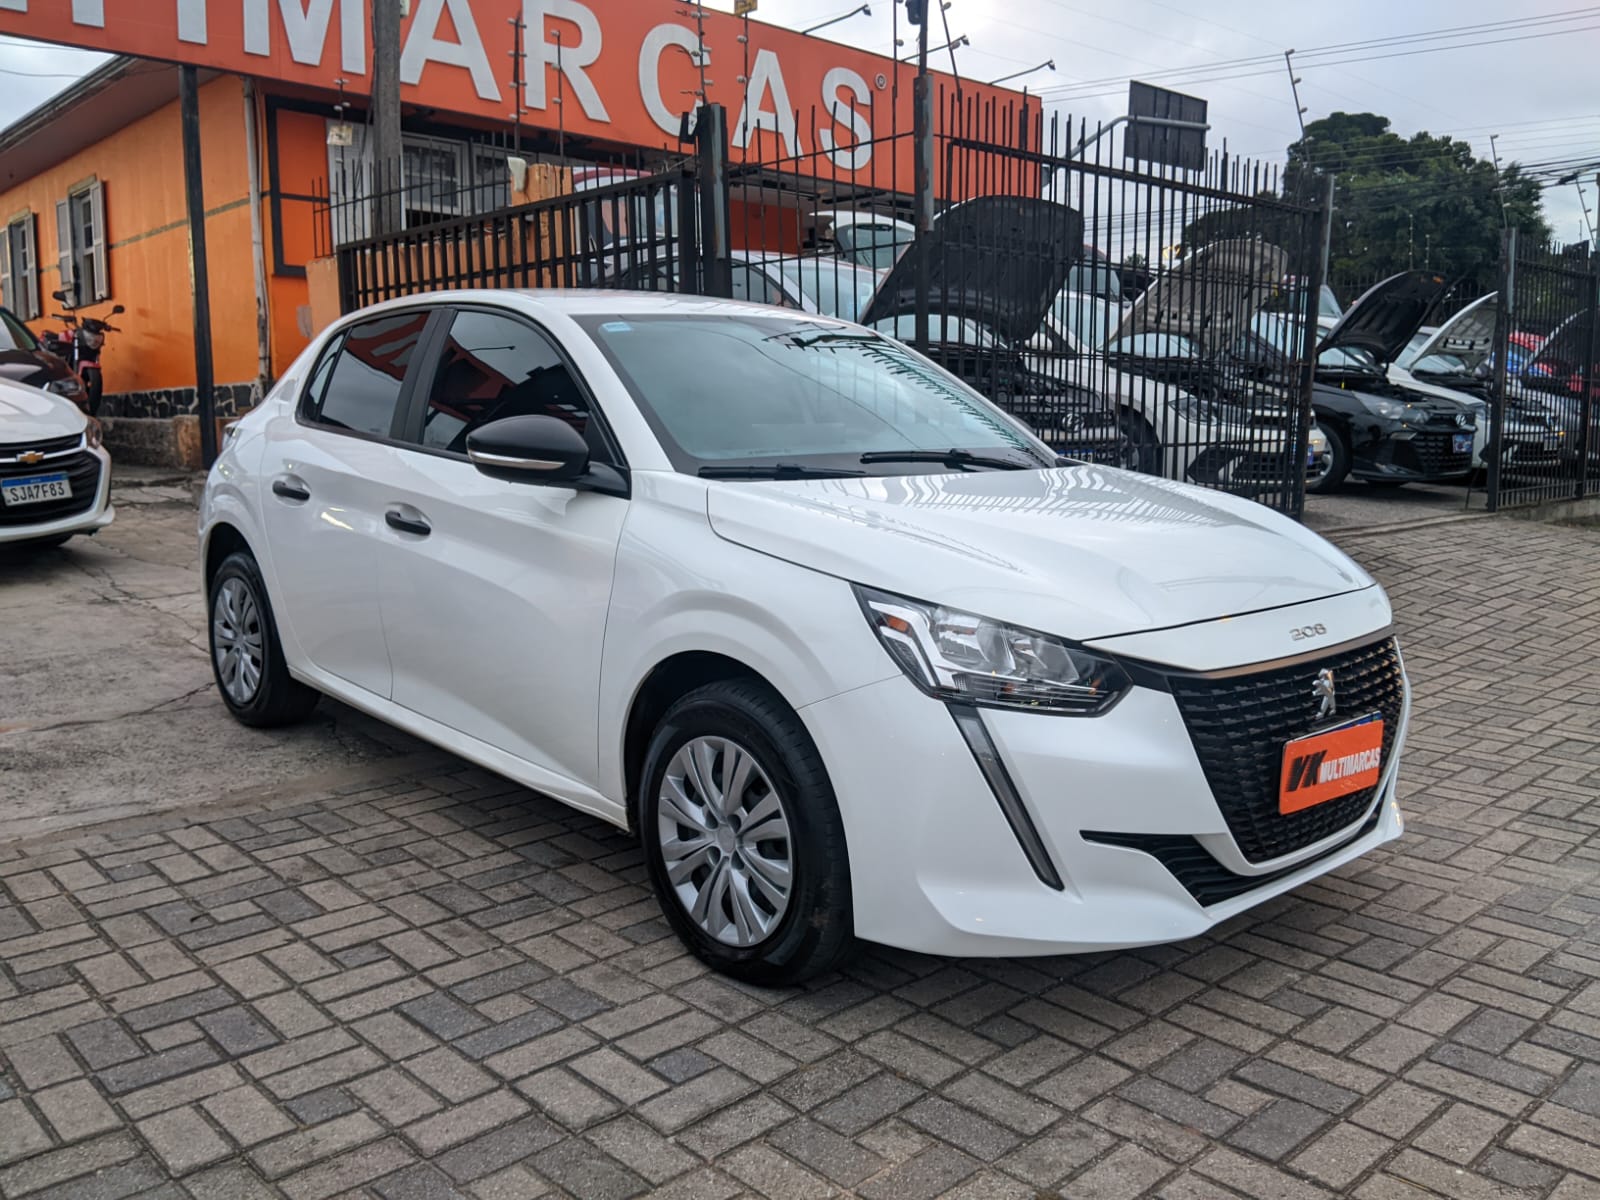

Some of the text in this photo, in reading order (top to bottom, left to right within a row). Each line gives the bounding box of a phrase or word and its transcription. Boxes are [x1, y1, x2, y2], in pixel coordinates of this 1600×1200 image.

[10, 482, 65, 502] SJA7F83
[1289, 623, 1327, 641] 208
[1319, 747, 1381, 784] MULTIMARCAS
